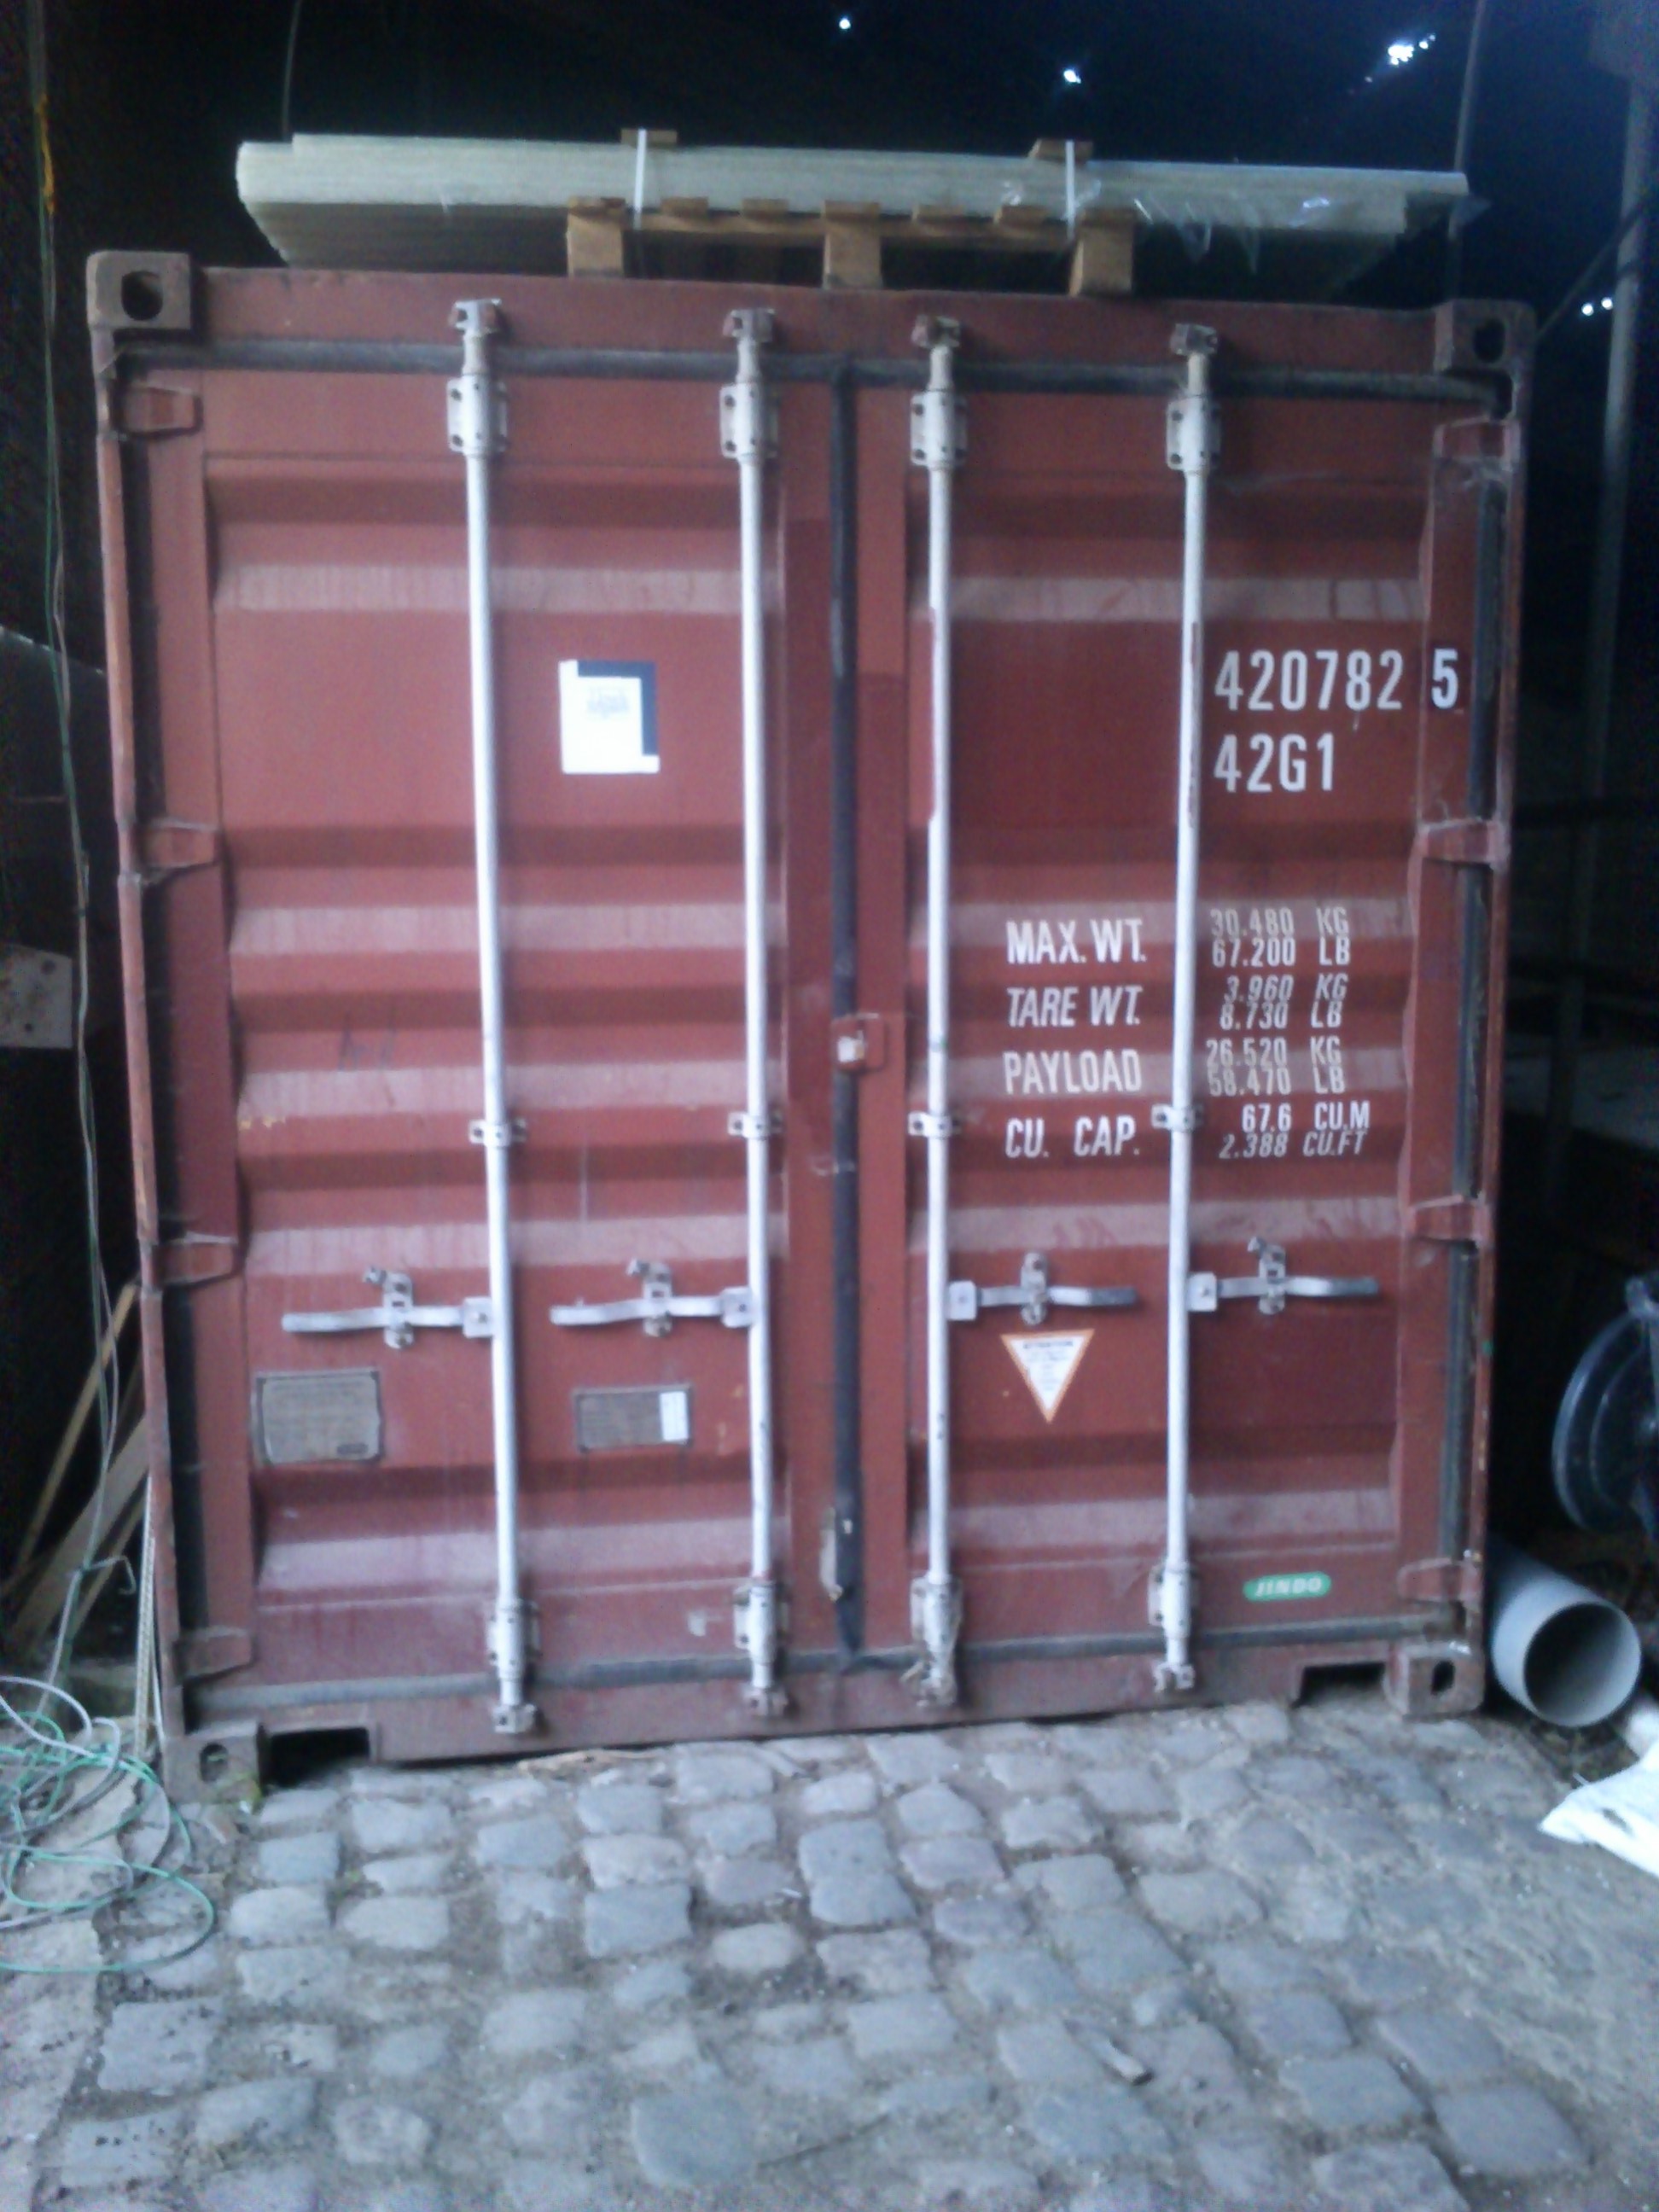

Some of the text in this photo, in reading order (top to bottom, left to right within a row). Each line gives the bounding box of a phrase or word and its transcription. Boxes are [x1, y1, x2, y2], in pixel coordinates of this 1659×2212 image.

[1214, 648, 1459, 711] 420782 5
[1214, 732, 1334, 793] 42G1
[1209, 906, 1349, 938] 30.480 KG
[1005, 917, 1147, 964] MAX. WT.
[1212, 935, 1351, 968] 67.200 LB
[1223, 973, 1349, 1004] 3.960 KG
[1006, 985, 1144, 1027] TARE WT.
[1219, 1000, 1343, 1031] 8.730 LB
[1310, 1035, 1342, 1066] KG
[1003, 1049, 1143, 1095] PAYLOAD
[1313, 1065, 1346, 1095] LB
[1241, 1103, 1292, 1133] 67.6
[1004, 1115, 1140, 1159] CU. CAP.
[1218, 1131, 1289, 1160] 2.388
[1254, 1576, 1323, 1598] JINDO
